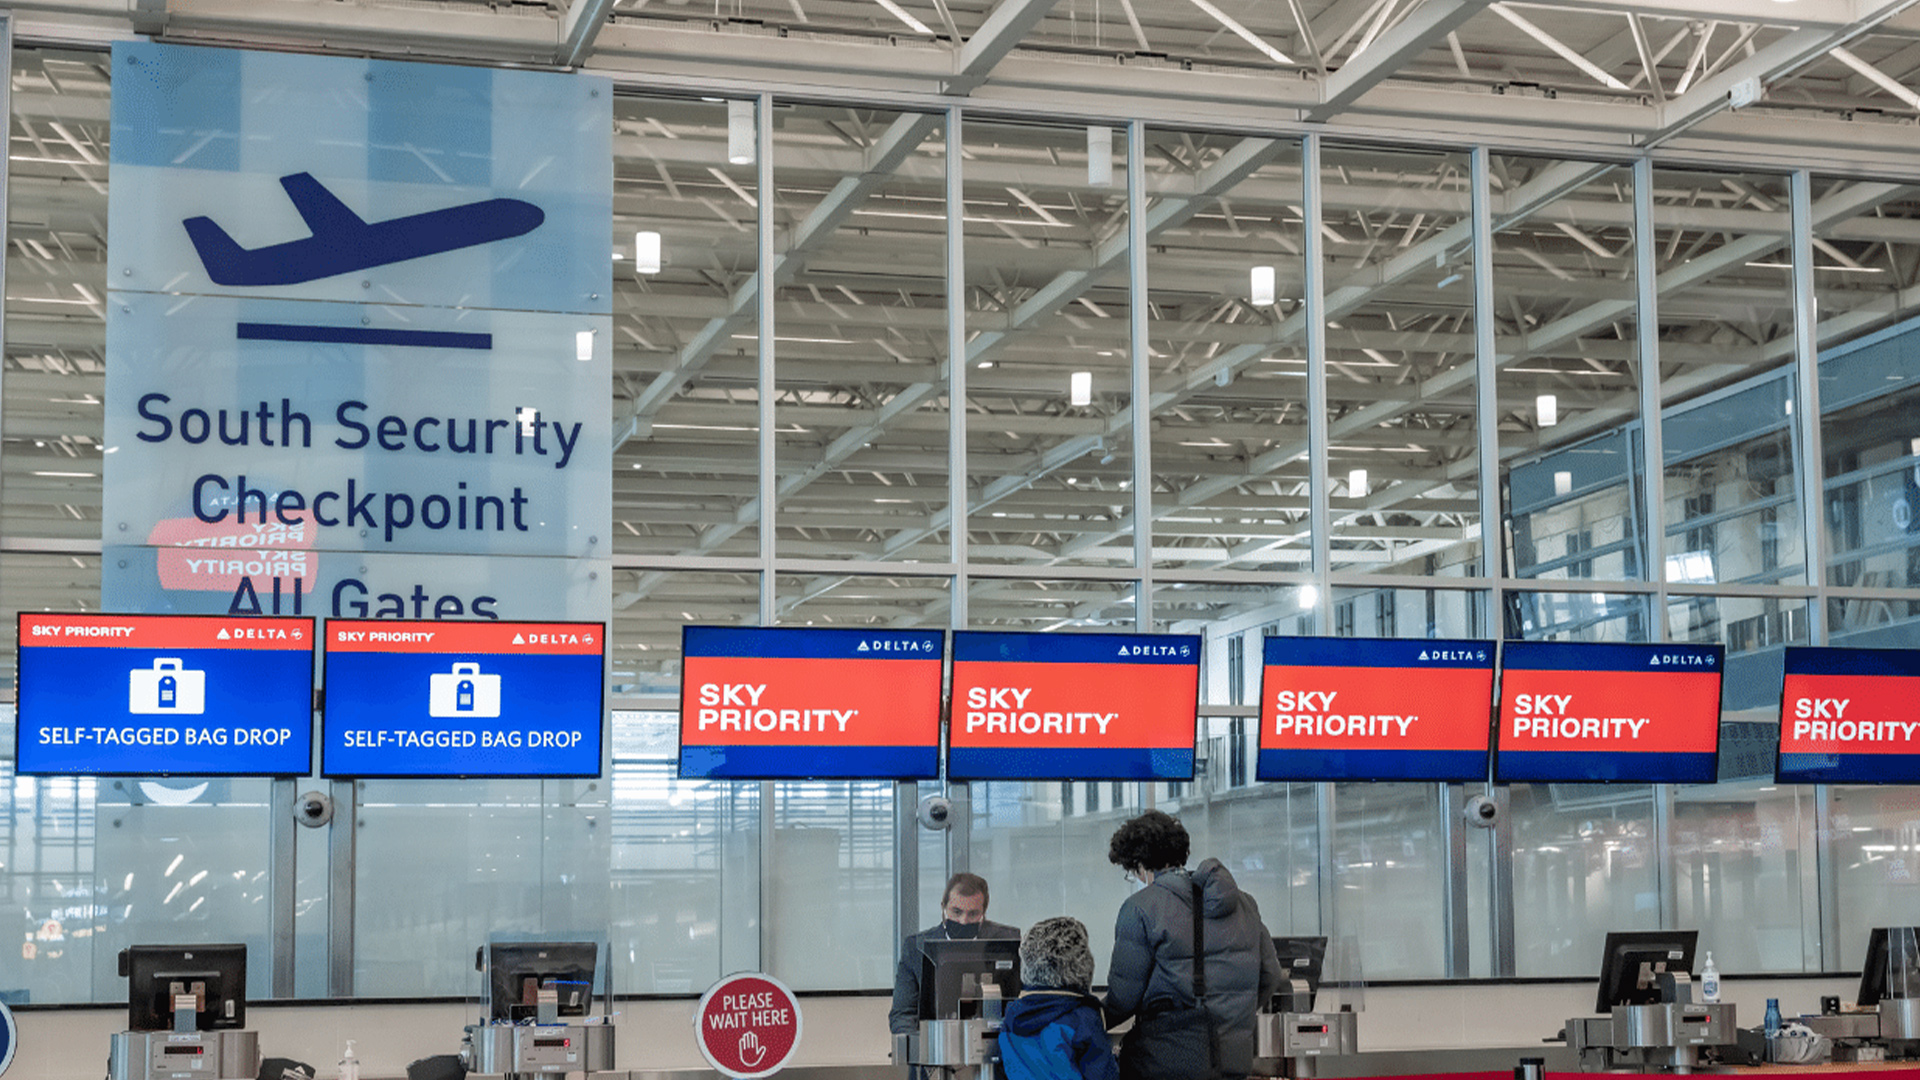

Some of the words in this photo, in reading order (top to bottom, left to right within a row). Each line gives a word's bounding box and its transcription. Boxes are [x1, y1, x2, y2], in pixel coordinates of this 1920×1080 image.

[136, 392, 312, 448] South
[334, 399, 583, 469] Security
[192, 474, 529, 543] Checkpoint
[228, 576, 303, 615] All
[331, 578, 499, 619] Gates
[31, 624, 62, 637] SKY
[65, 625, 133, 638] PRIORITY
[233, 627, 287, 640] DELTA
[337, 631, 366, 643] SKY
[369, 631, 432, 643] PRIORITY
[528, 633, 579, 645] DELTA
[873, 640, 919, 651] DELTA
[1133, 646, 1177, 657] DELTA
[1432, 651, 1473, 661] DELTA
[1662, 654, 1703, 665] DELTA
[698, 682, 768, 706] SKY
[966, 687, 1032, 710] SKY
[1276, 690, 1338, 712] SKY
[1514, 693, 1573, 715] SKY
[1794, 697, 1850, 719] SKY
[698, 708, 854, 732] PRIORITY
[966, 711, 1113, 734] PRIORITY
[1275, 714, 1414, 737] PRIORITY
[1513, 717, 1645, 739] PRIORITY
[1793, 720, 1917, 741] PRIORITY
[38, 726, 180, 746] SELF-TAGGED
[185, 728, 228, 746] BAG
[233, 728, 292, 746] DROP
[344, 730, 477, 748] SELF-TAGGED
[481, 731, 522, 748] BAG
[528, 731, 583, 748] DROP
[723, 992, 773, 1011] PLEASE
[709, 1011, 747, 1030] WAIT
[752, 1008, 789, 1027] HERE
